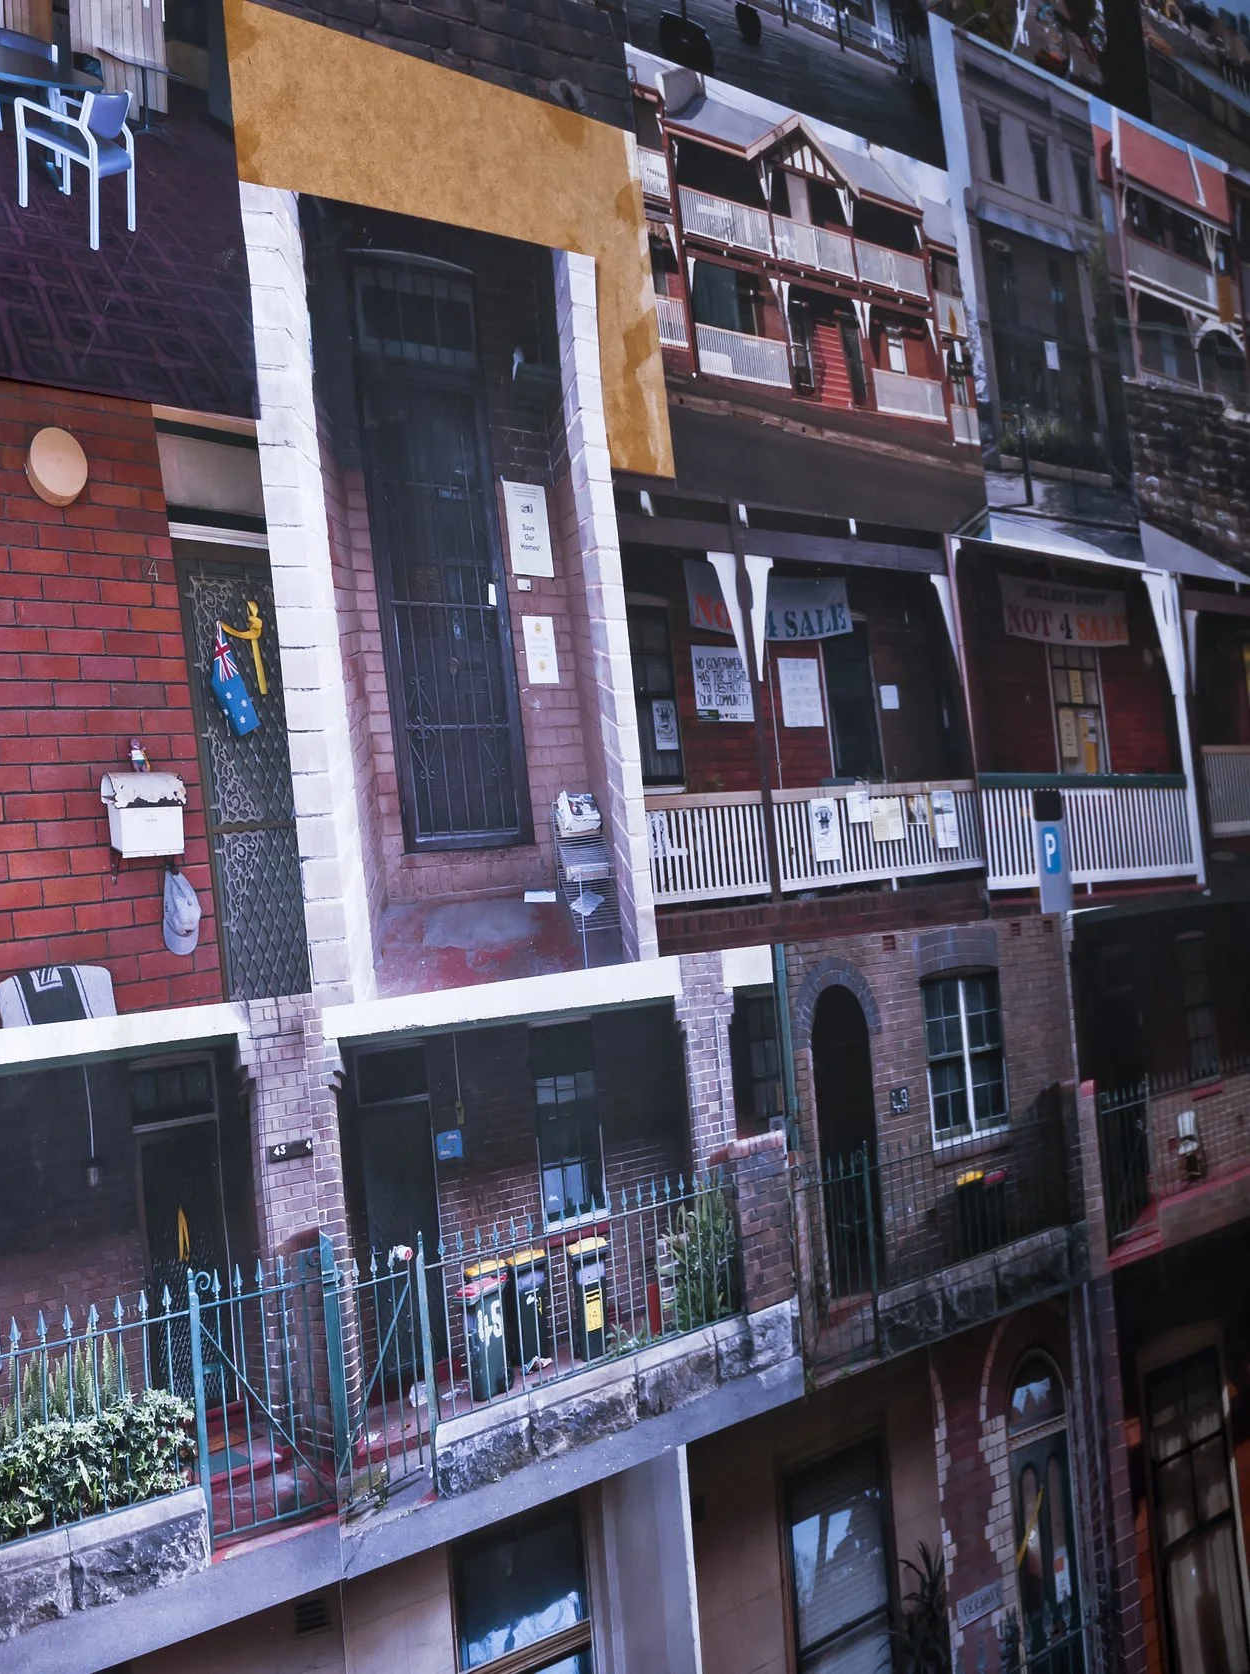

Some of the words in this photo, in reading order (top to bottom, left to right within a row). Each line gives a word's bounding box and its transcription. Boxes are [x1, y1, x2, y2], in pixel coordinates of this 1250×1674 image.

[521, 523, 536, 532] Save
[524, 533, 535, 542] Our
[520, 542, 541, 552] Homes!
[147, 561, 158, 581] 4
[784, 602, 847, 638] SALE
[1007, 603, 1053, 637] NOT
[1059, 613, 1073, 640] 4
[1075, 611, 1129, 641] SALE
[694, 657, 705, 670] NO
[706, 656, 743, 671] GOVERNMEN
[696, 669, 710, 683] HAS
[712, 669, 724, 683] THE
[702, 682, 712, 694] TO
[699, 693, 713, 707] OUR
[1044, 832, 1058, 869] P
[273, 1144, 287, 1156] 43
